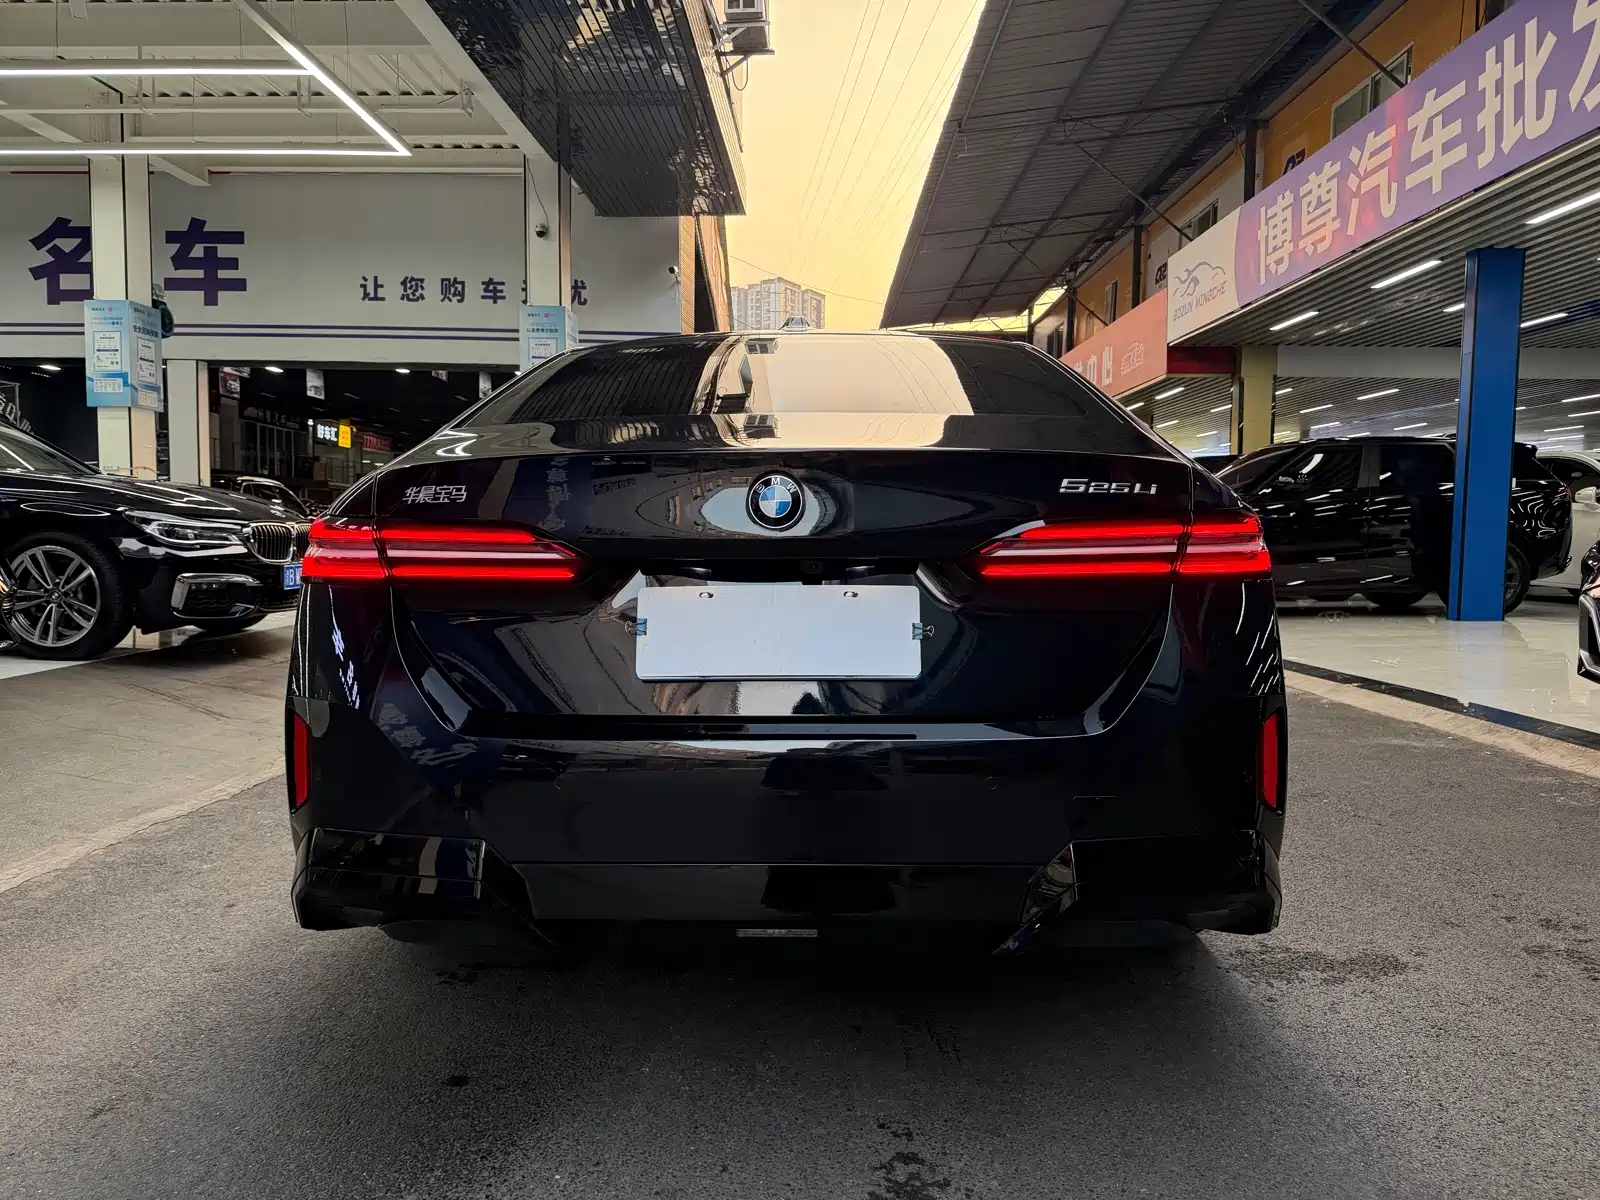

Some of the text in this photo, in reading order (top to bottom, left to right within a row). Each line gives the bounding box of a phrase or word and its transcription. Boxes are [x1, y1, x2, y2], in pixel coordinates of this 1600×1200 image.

[359, 276, 588, 306] 让您购车忧
[402, 485, 467, 504] 华晨宝马
[754, 477, 798, 494] BMW
[1059, 478, 1158, 495] 525Li
